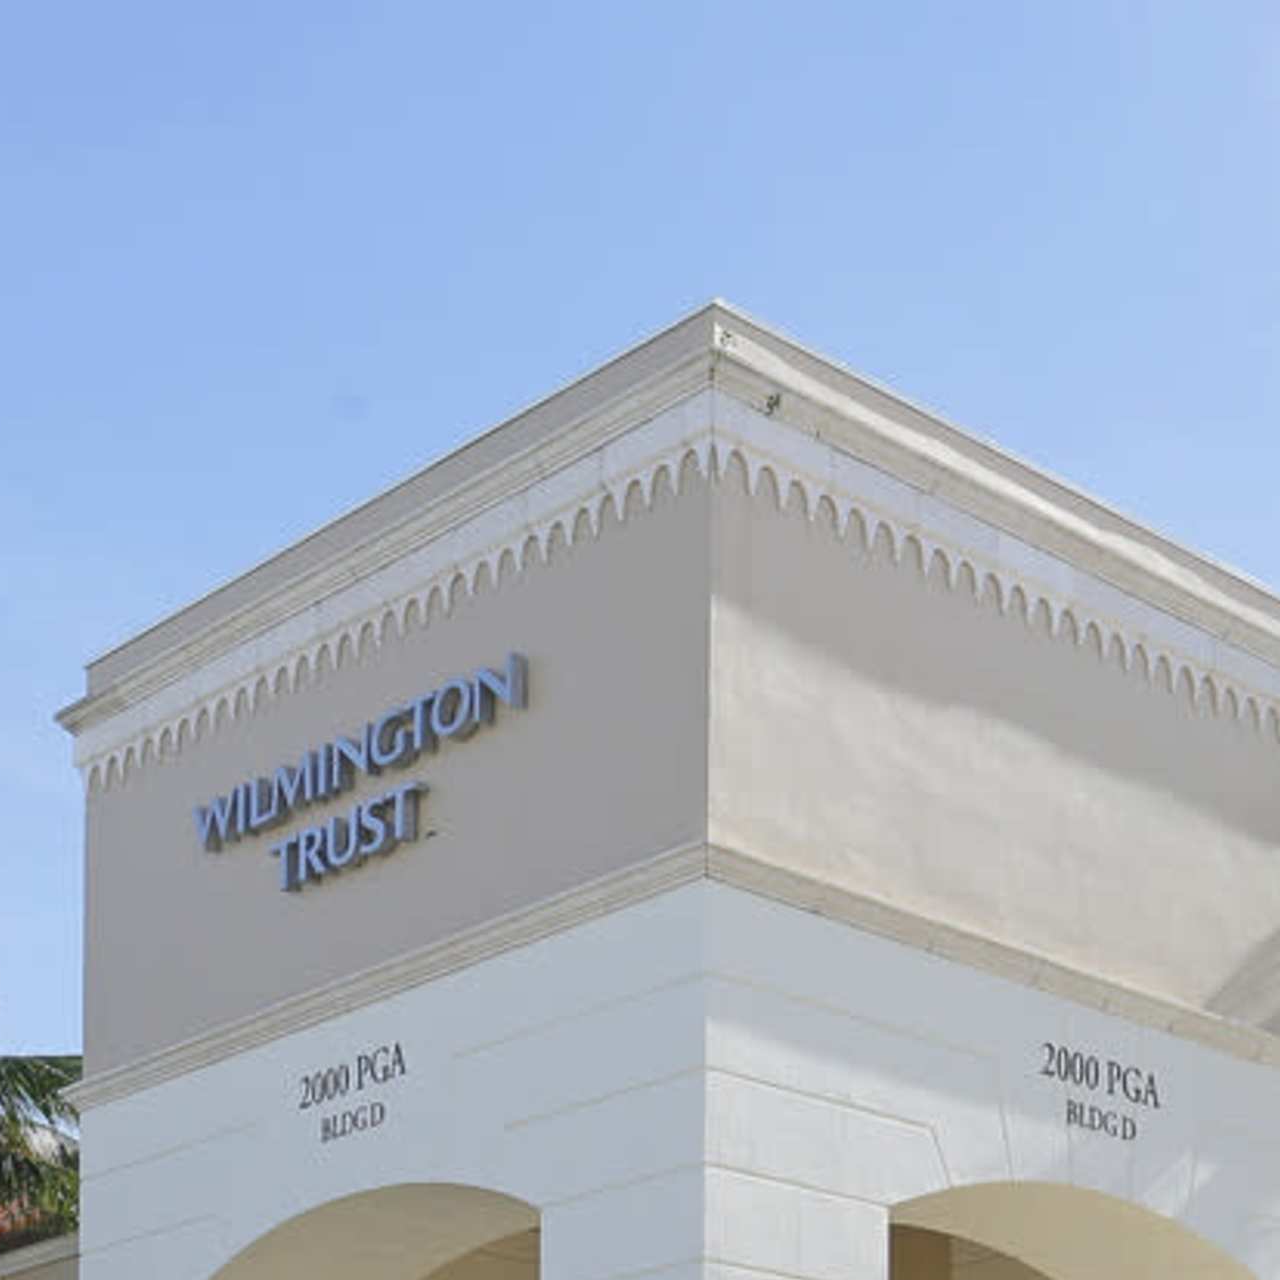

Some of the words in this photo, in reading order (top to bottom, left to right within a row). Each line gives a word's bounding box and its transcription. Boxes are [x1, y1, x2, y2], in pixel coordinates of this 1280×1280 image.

[193, 652, 527, 852] WILMINGTON
[273, 779, 429, 890] TRUST
[299, 1065, 350, 1109] 2000
[356, 1042, 406, 1090] PGA
[1040, 1042, 1099, 1090] 2000
[1106, 1060, 1160, 1109] PGA
[321, 1105, 368, 1143] BLDG
[370, 1102, 385, 1128] D
[1066, 1099, 1118, 1137] BLDG
[1122, 1115, 1137, 1140] D
